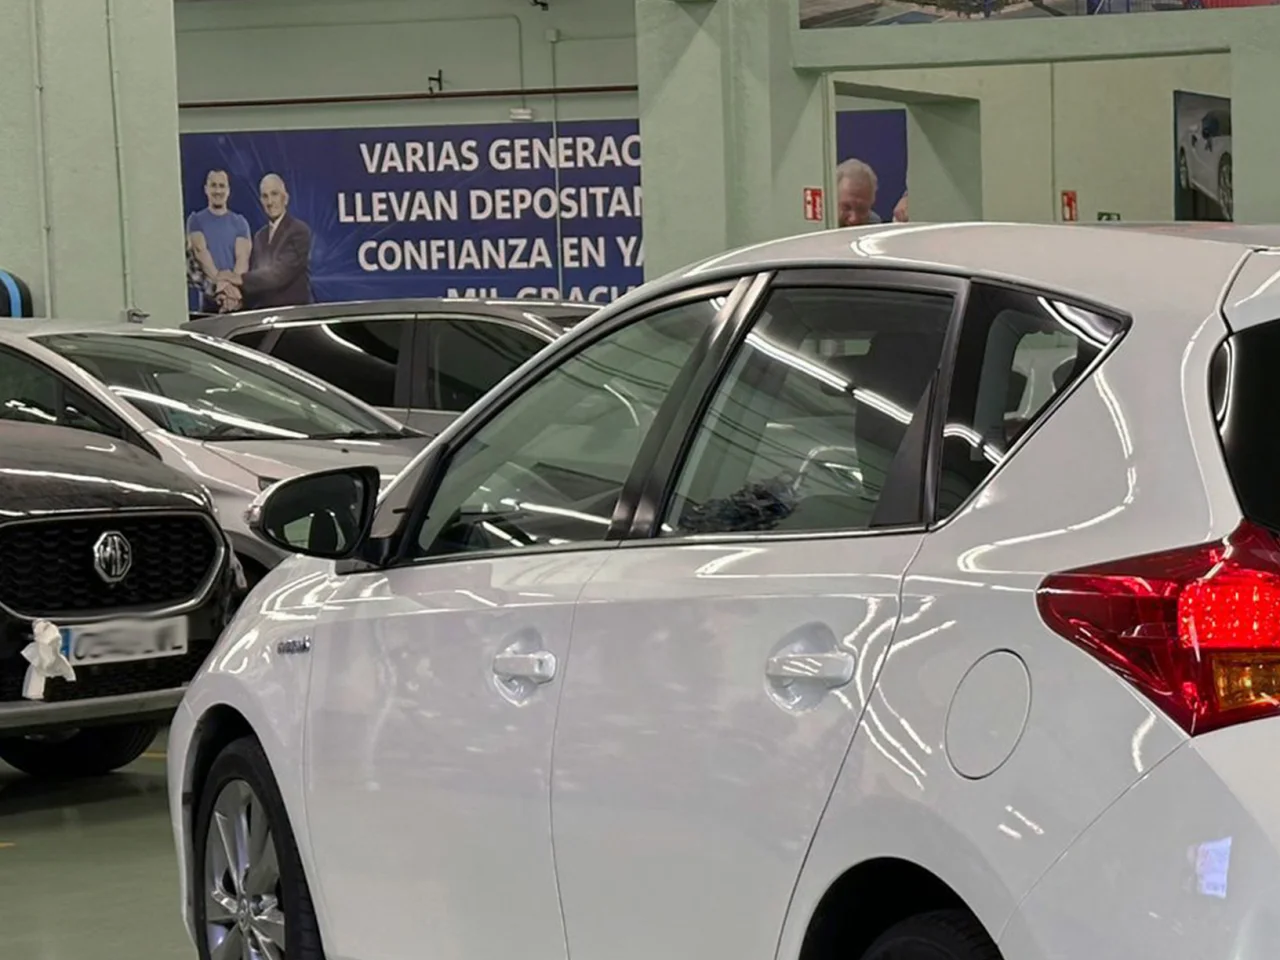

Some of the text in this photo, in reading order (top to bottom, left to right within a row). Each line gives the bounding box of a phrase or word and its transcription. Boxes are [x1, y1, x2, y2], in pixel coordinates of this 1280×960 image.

[359, 133, 642, 174] VARIAS GENERAC
[337, 189, 459, 223] LLEVAN
[357, 238, 553, 272] CONFIANZA
[562, 236, 606, 268] EN
